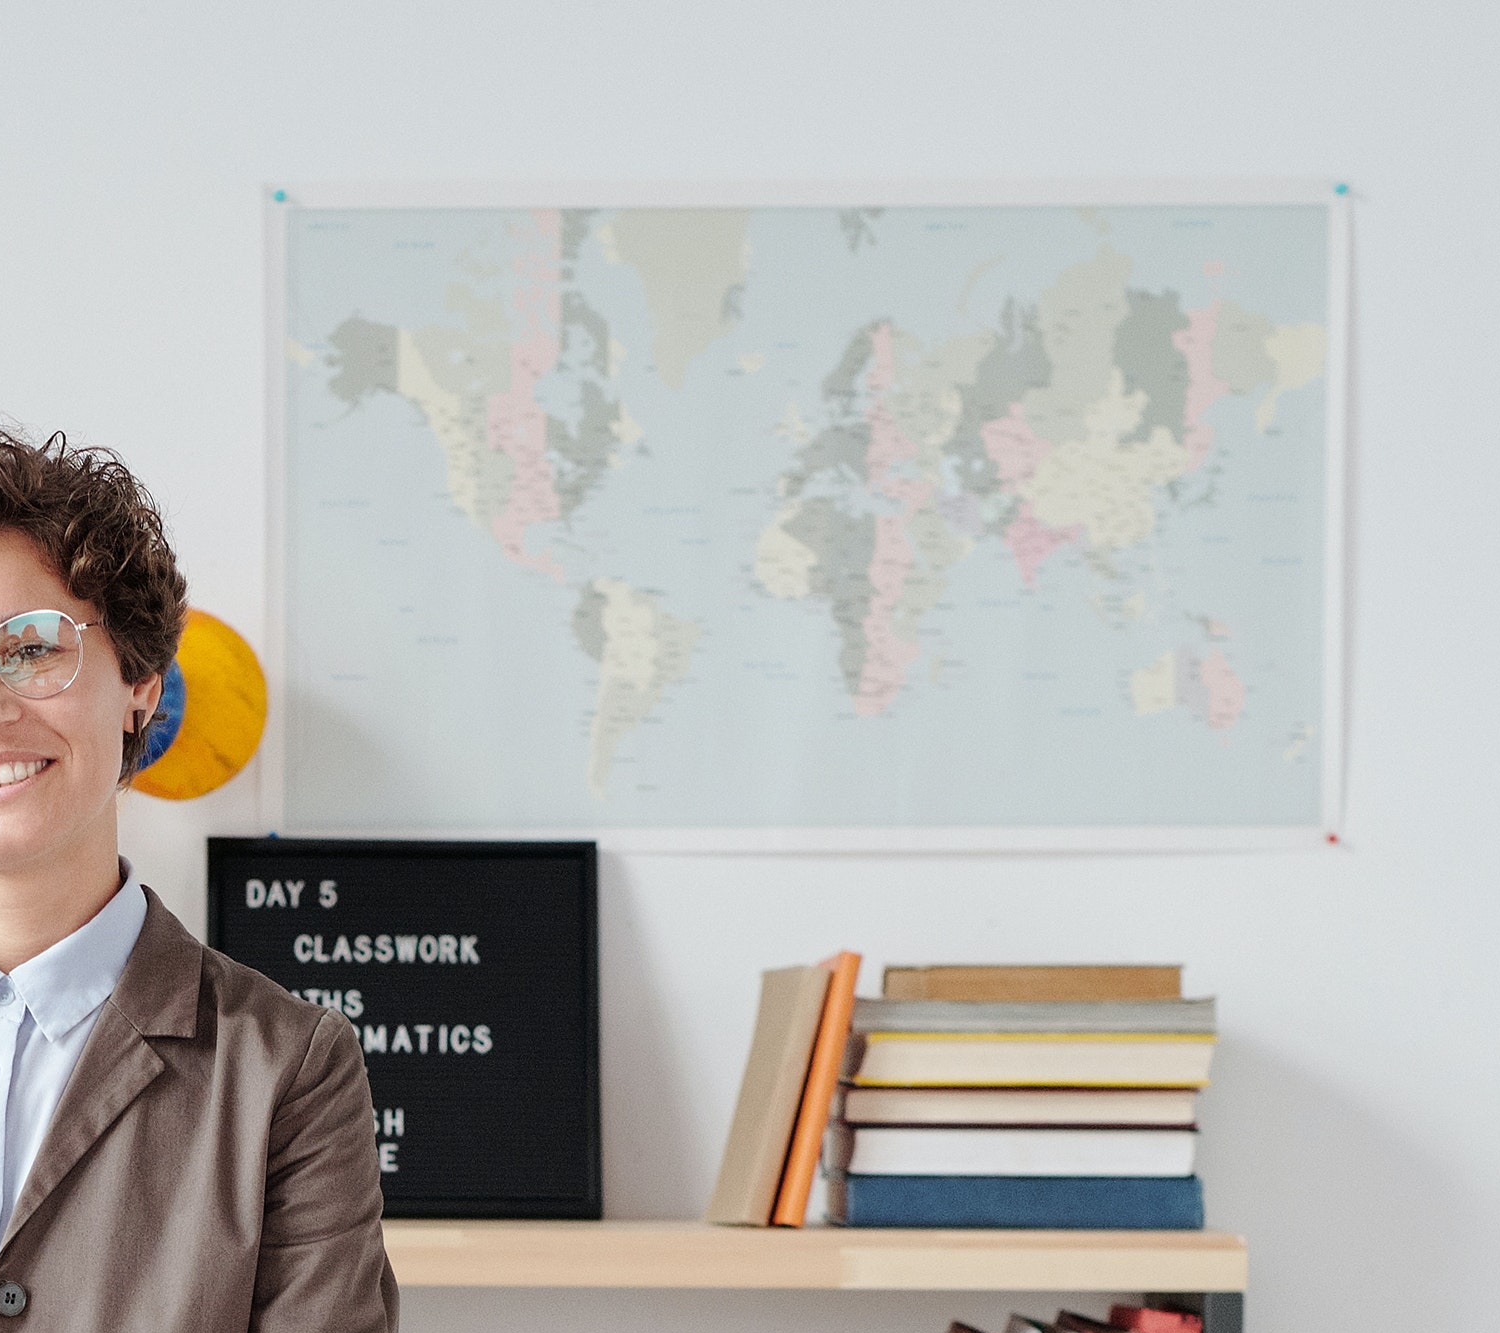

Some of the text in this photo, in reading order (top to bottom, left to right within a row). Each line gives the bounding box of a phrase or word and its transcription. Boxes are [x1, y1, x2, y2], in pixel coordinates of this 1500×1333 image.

[245, 879, 338, 909] DAY 5
[293, 934, 480, 964] CLASSWORK
[290, 988, 365, 1018] THS
[353, 1024, 493, 1054] MATICS
